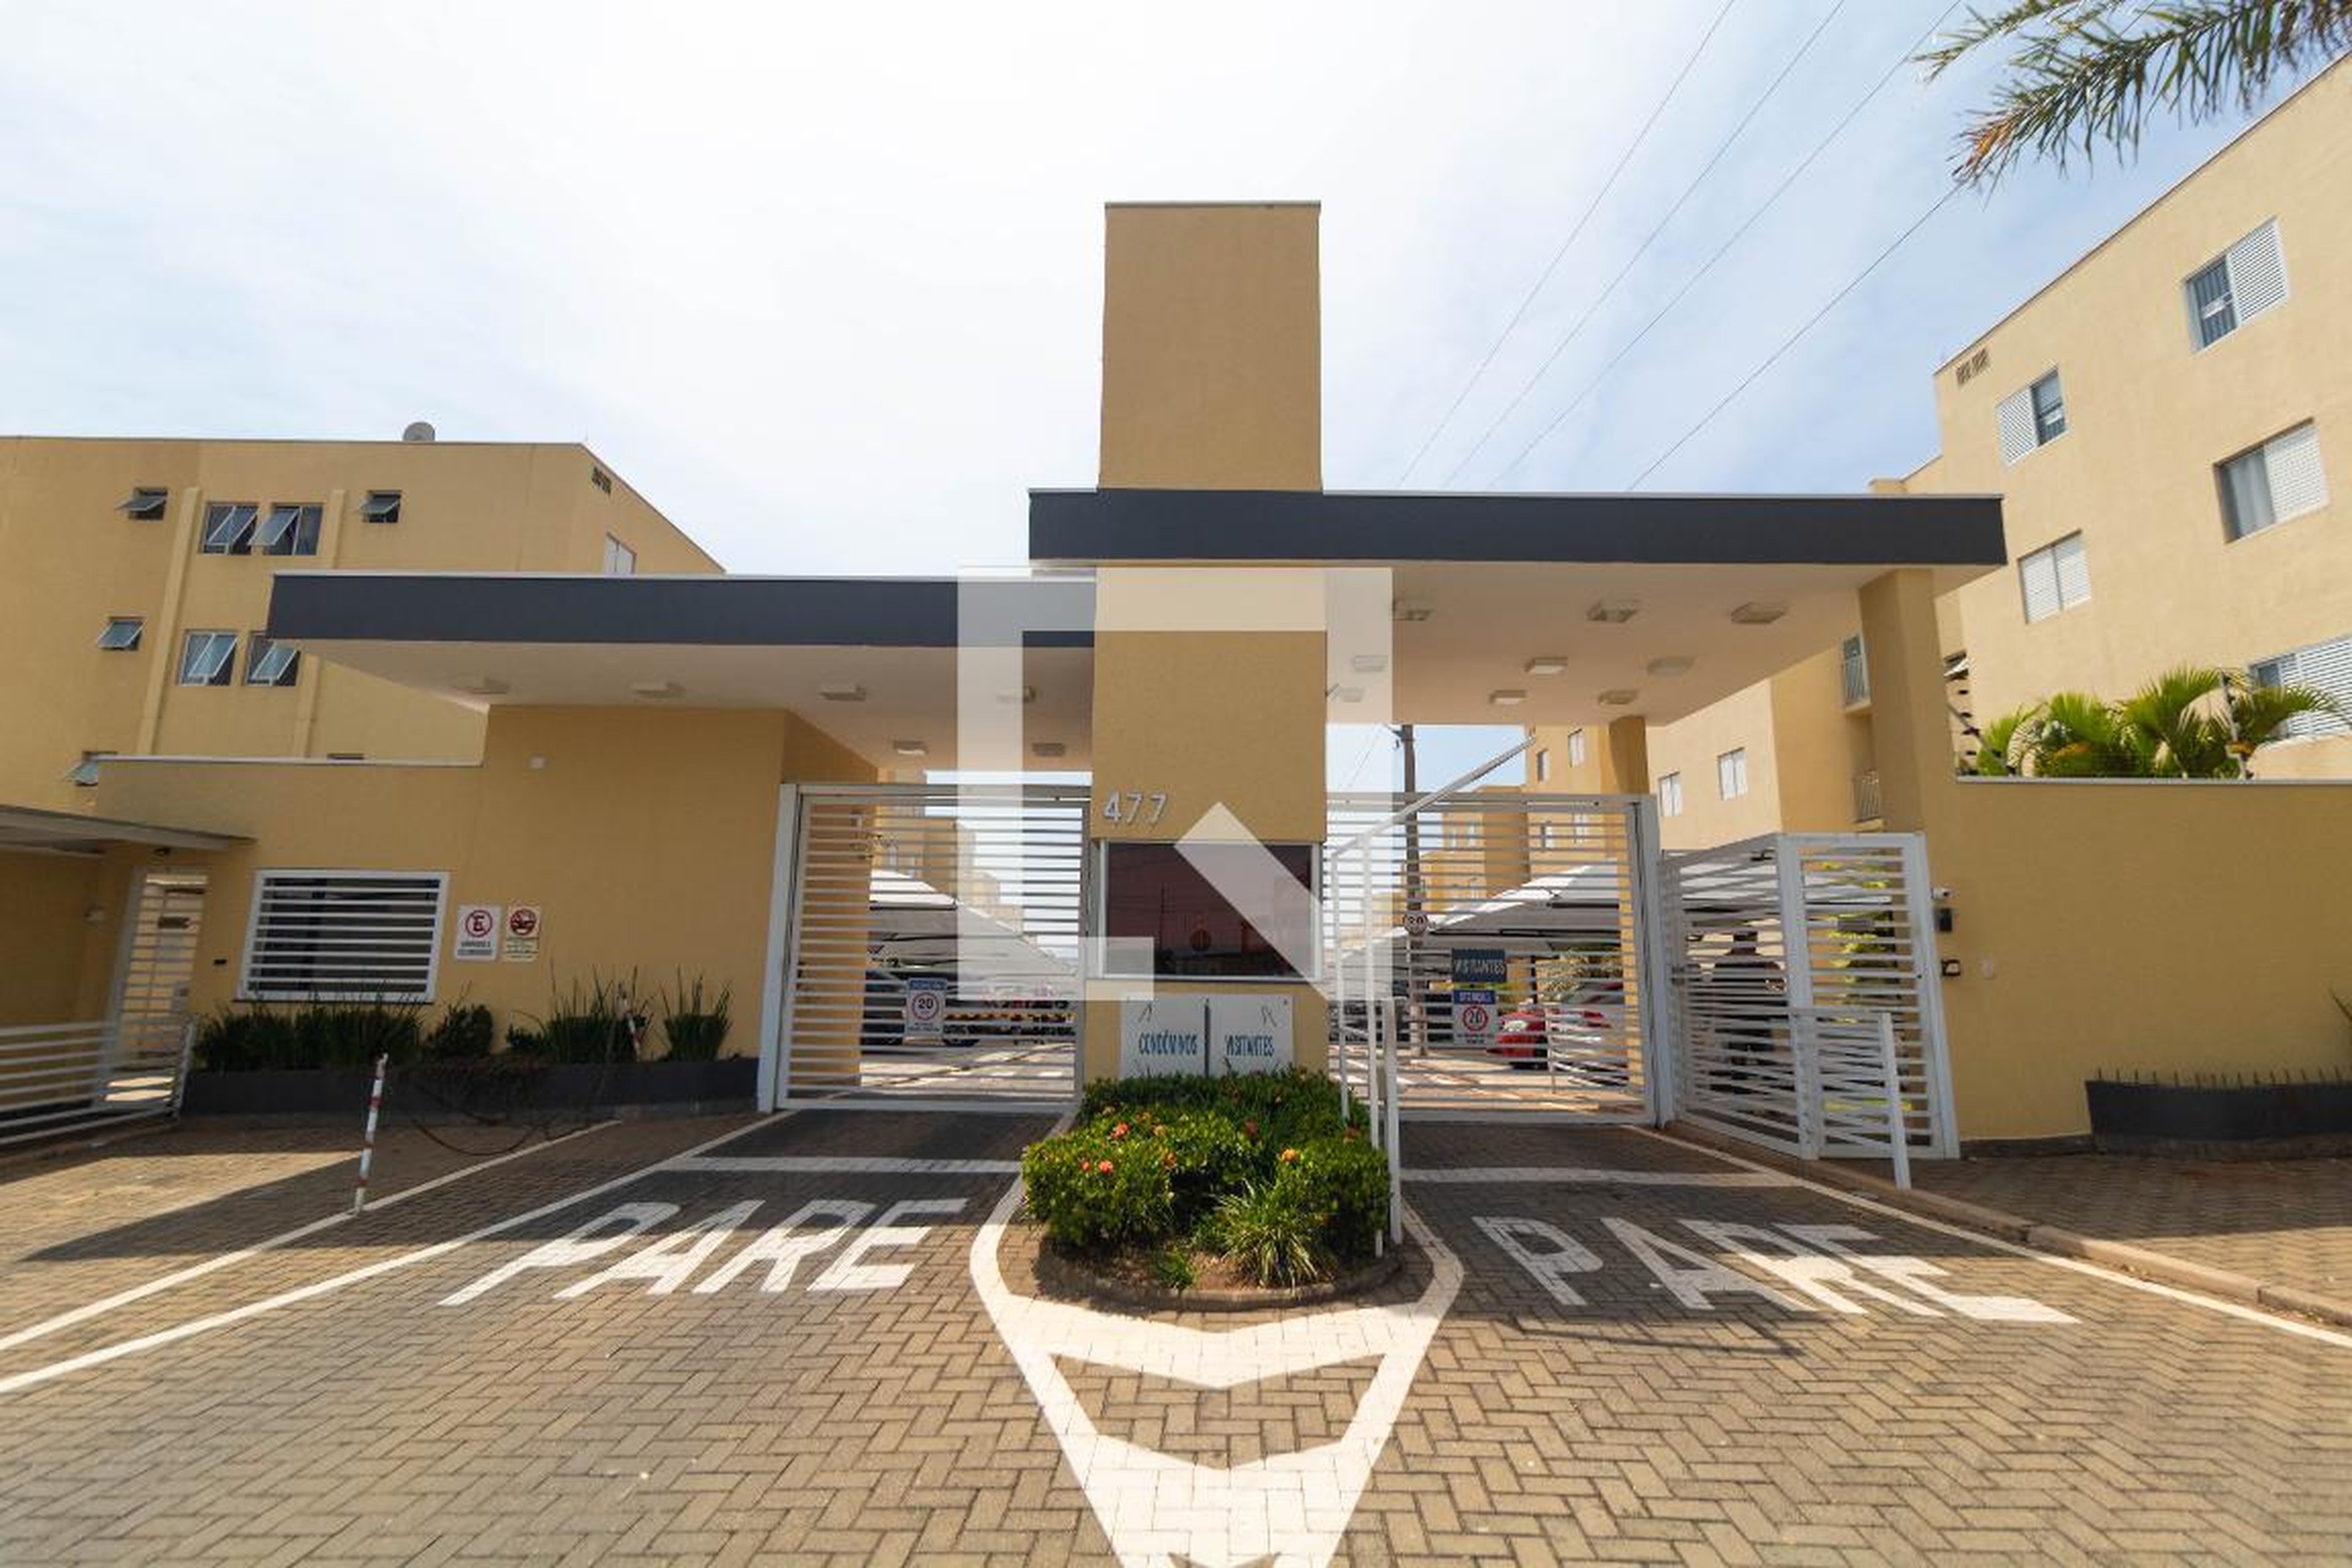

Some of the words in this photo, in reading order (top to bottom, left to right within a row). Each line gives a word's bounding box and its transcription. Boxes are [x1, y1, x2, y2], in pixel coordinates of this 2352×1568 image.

[1104, 791, 1166, 823] 477
[918, 998, 933, 1009] 20
[437, 1197, 968, 1307] PARE
[1471, 1216, 2082, 1324] PARE
